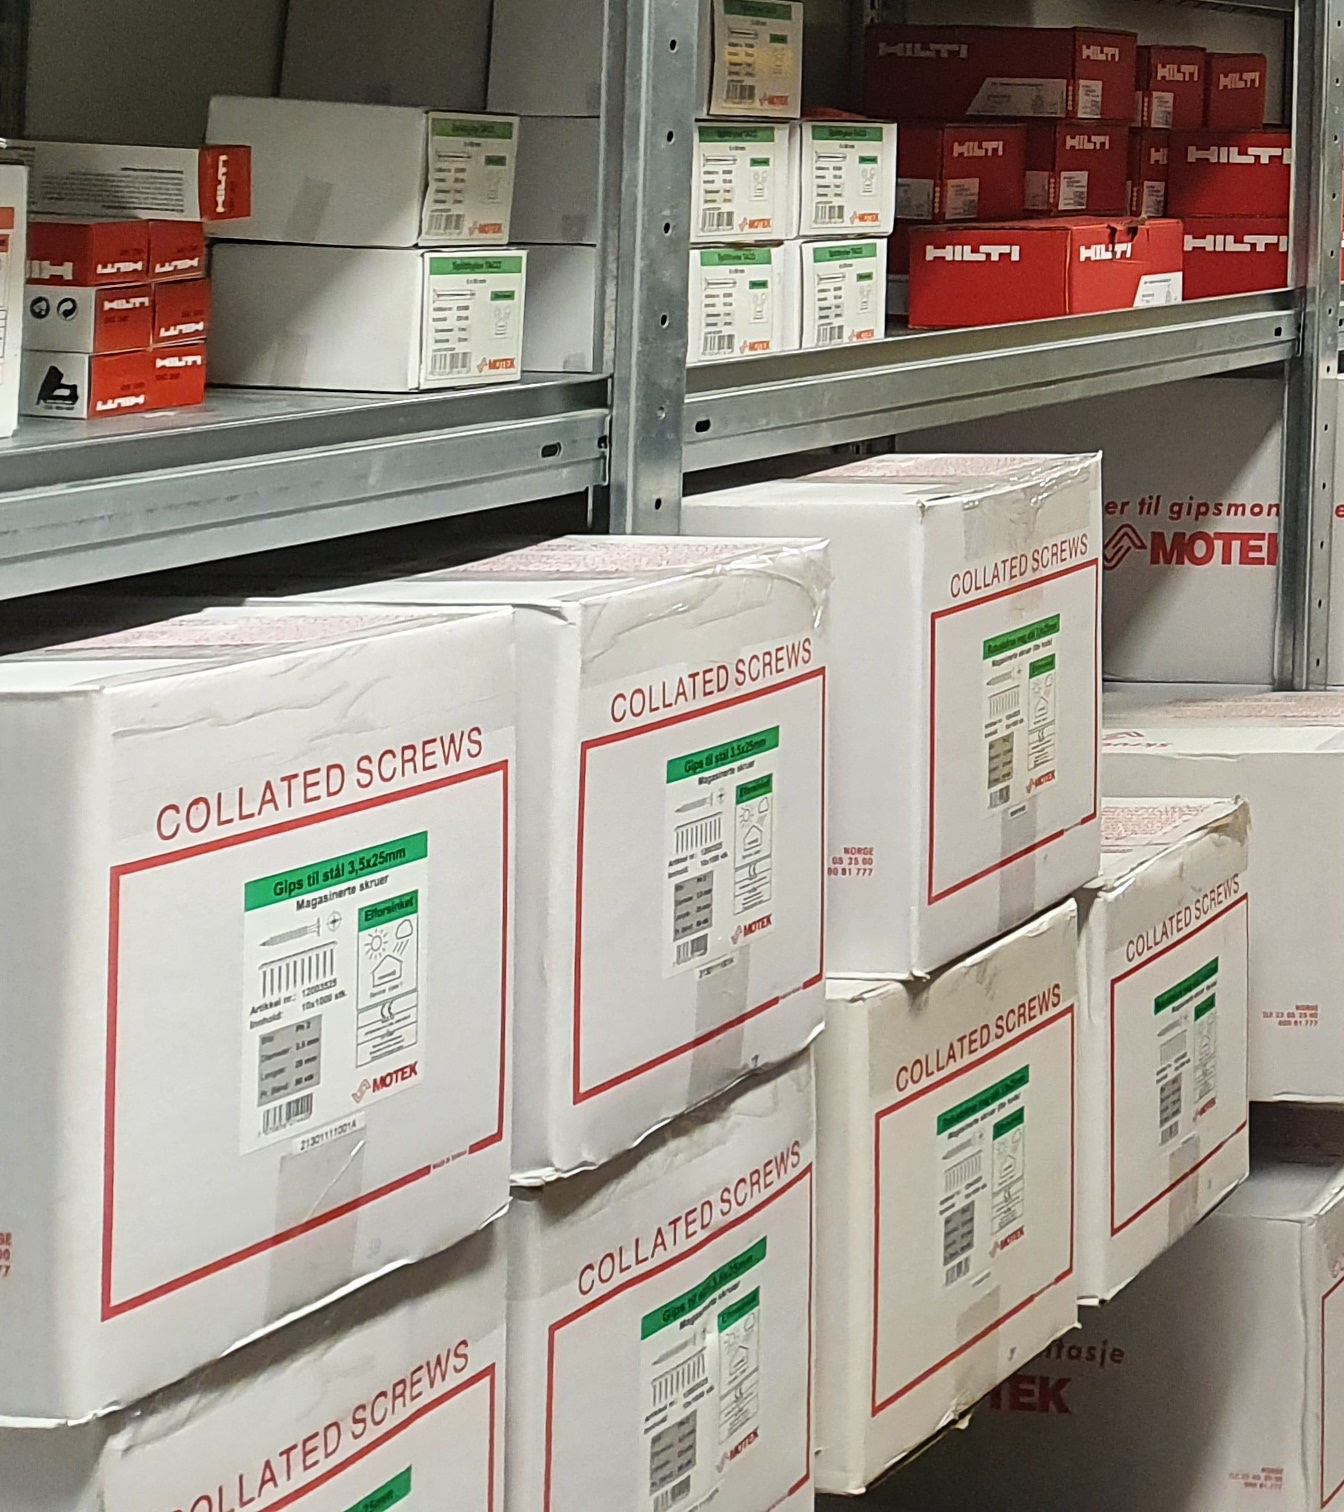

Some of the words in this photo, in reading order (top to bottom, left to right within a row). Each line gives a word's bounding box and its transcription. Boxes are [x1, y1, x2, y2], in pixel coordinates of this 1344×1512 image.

[879, 42, 968, 59] HILTI
[1081, 44, 1120, 62] HILTI
[1157, 63, 1199, 82] HILTI
[1218, 71, 1260, 90] HILTI
[953, 140, 1004, 158] HILTI
[1066, 134, 1111, 151] HILTI
[1188, 146, 1291, 165] HILTI
[925, 244, 1020, 262] HILTI
[1080, 242, 1131, 261] HILTI
[1184, 235, 1287, 252] HILTI
[1138, 495, 1161, 516] til
[951, 555, 1028, 598] COLLATED
[1031, 533, 1089, 572] SCREWS
[610, 669, 729, 724] COLLATED
[735, 637, 813, 687] SCREWS
[156, 762, 345, 842] COLLATED
[357, 726, 484, 789] SCREWS
[843, 846, 874, 856] NORGE
[273, 878, 304, 898] Gips
[308, 870, 321, 888] til
[323, 862, 345, 884] stål
[348, 846, 406, 876] 3,5x25mm
[827, 867, 839, 876] 00
[856, 868, 873, 877] 777
[296, 884, 356, 912] Magasinerte
[359, 873, 389, 894] skruer
[743, 914, 773, 938] MOTEK
[1126, 908, 1192, 963] COLLATED
[1195, 874, 1240, 920] SCREWS
[896, 1022, 991, 1093] COLLATED
[995, 983, 1062, 1041] SCREWS
[372, 1059, 418, 1094] MOTEK
[577, 1205, 715, 1296] COLLATED
[719, 1139, 802, 1217] SCREWS
[351, 1338, 470, 1441] SCREWS
